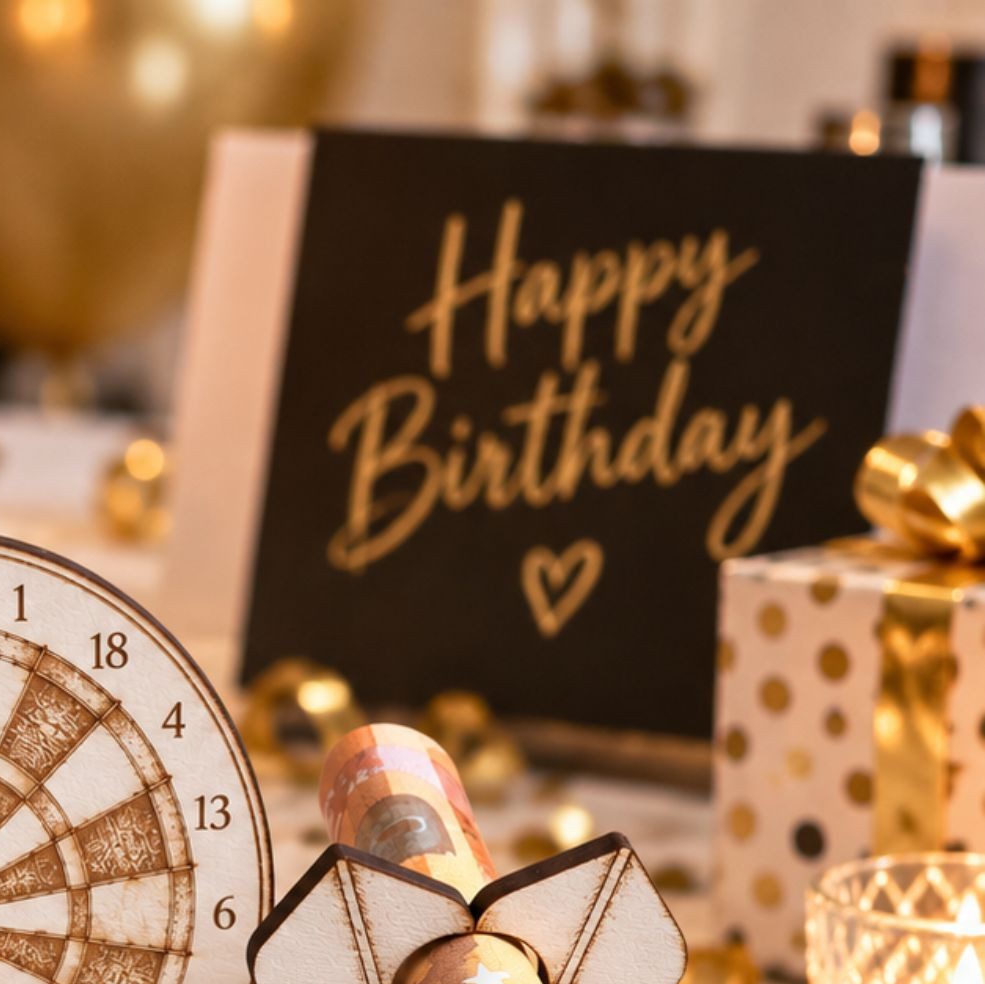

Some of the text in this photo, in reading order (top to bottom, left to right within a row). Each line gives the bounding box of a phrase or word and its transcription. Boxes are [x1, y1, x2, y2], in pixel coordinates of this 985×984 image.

[407, 198, 760, 379] Happy
[326, 356, 828, 572] Birthday
[13, 583, 28, 622] 1
[90, 631, 129, 670] 18
[161, 701, 186, 739] 4
[194, 794, 232, 831] 13
[213, 895, 237, 930] 6
